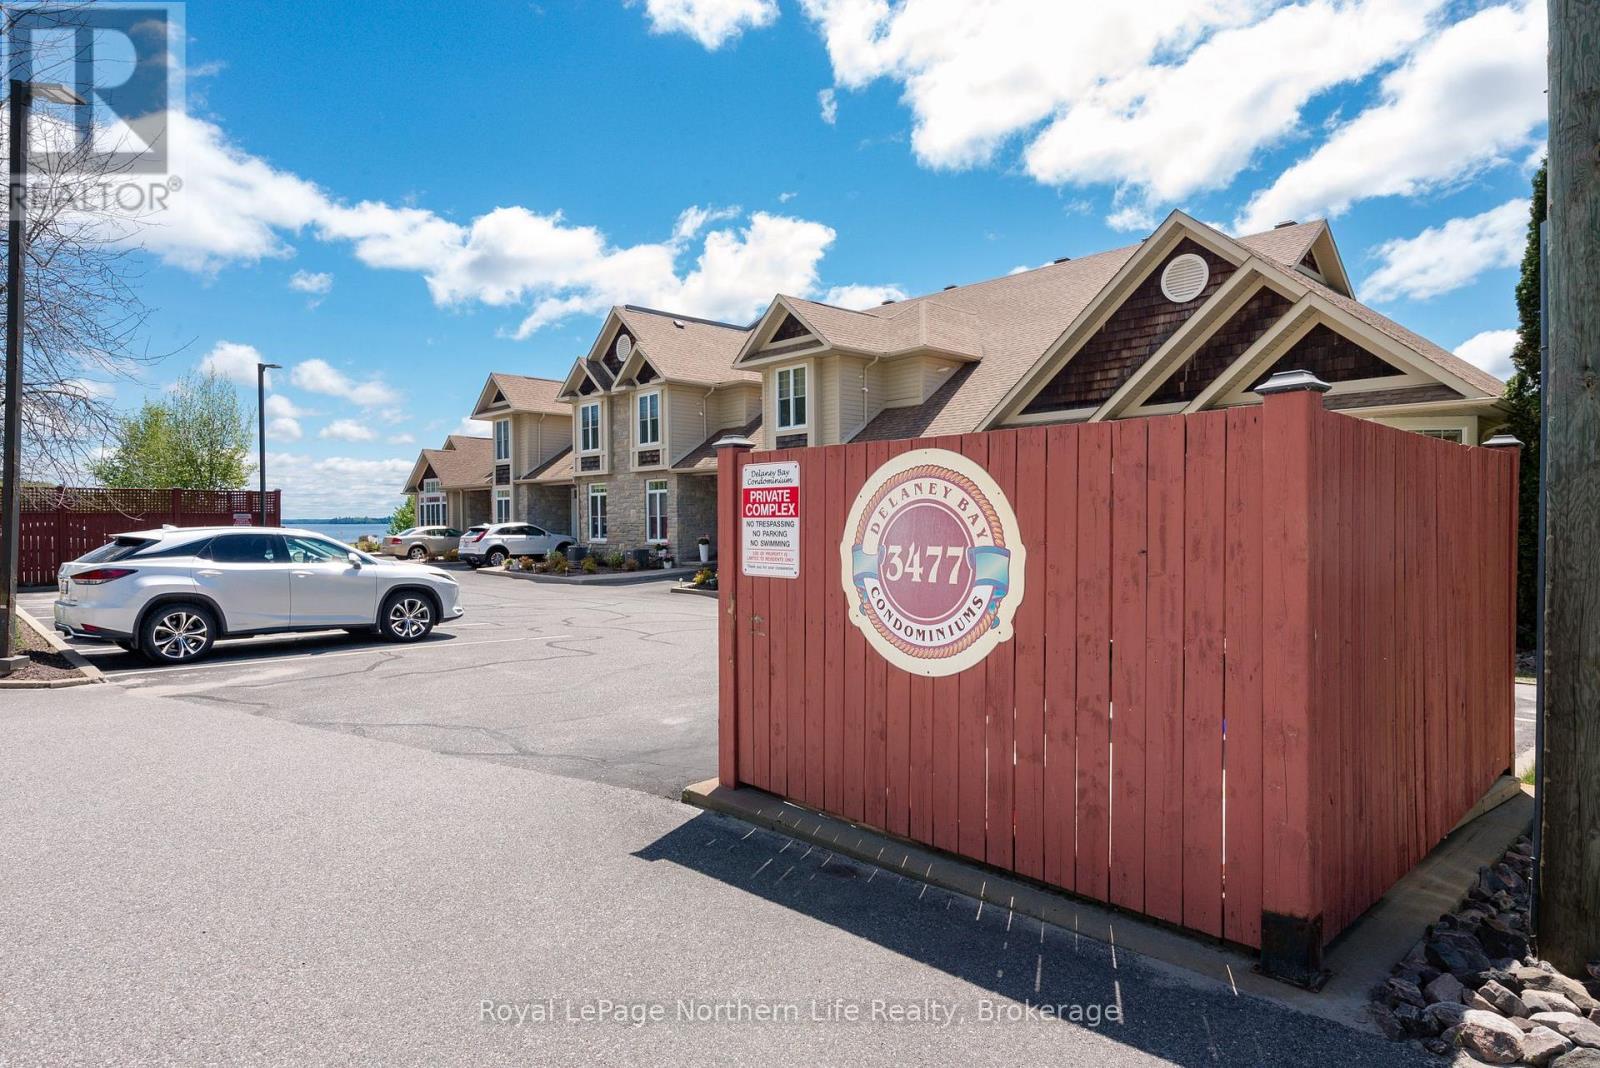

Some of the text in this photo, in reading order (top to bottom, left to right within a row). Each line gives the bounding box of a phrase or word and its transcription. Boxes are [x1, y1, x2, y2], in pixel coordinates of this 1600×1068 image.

[751, 469, 790, 477] Delaney Bay
[750, 489, 791, 503] PRIVATE
[745, 503, 796, 516] COMPLEX
[871, 482, 989, 540] DELANEY BAY
[746, 520, 795, 528] NO TRESPASSING
[762, 530, 788, 538] PARKING
[750, 539, 791, 548] NO SWIMMING
[886, 542, 964, 585] 3477
[871, 586, 984, 642] CONDOMINIUMS
